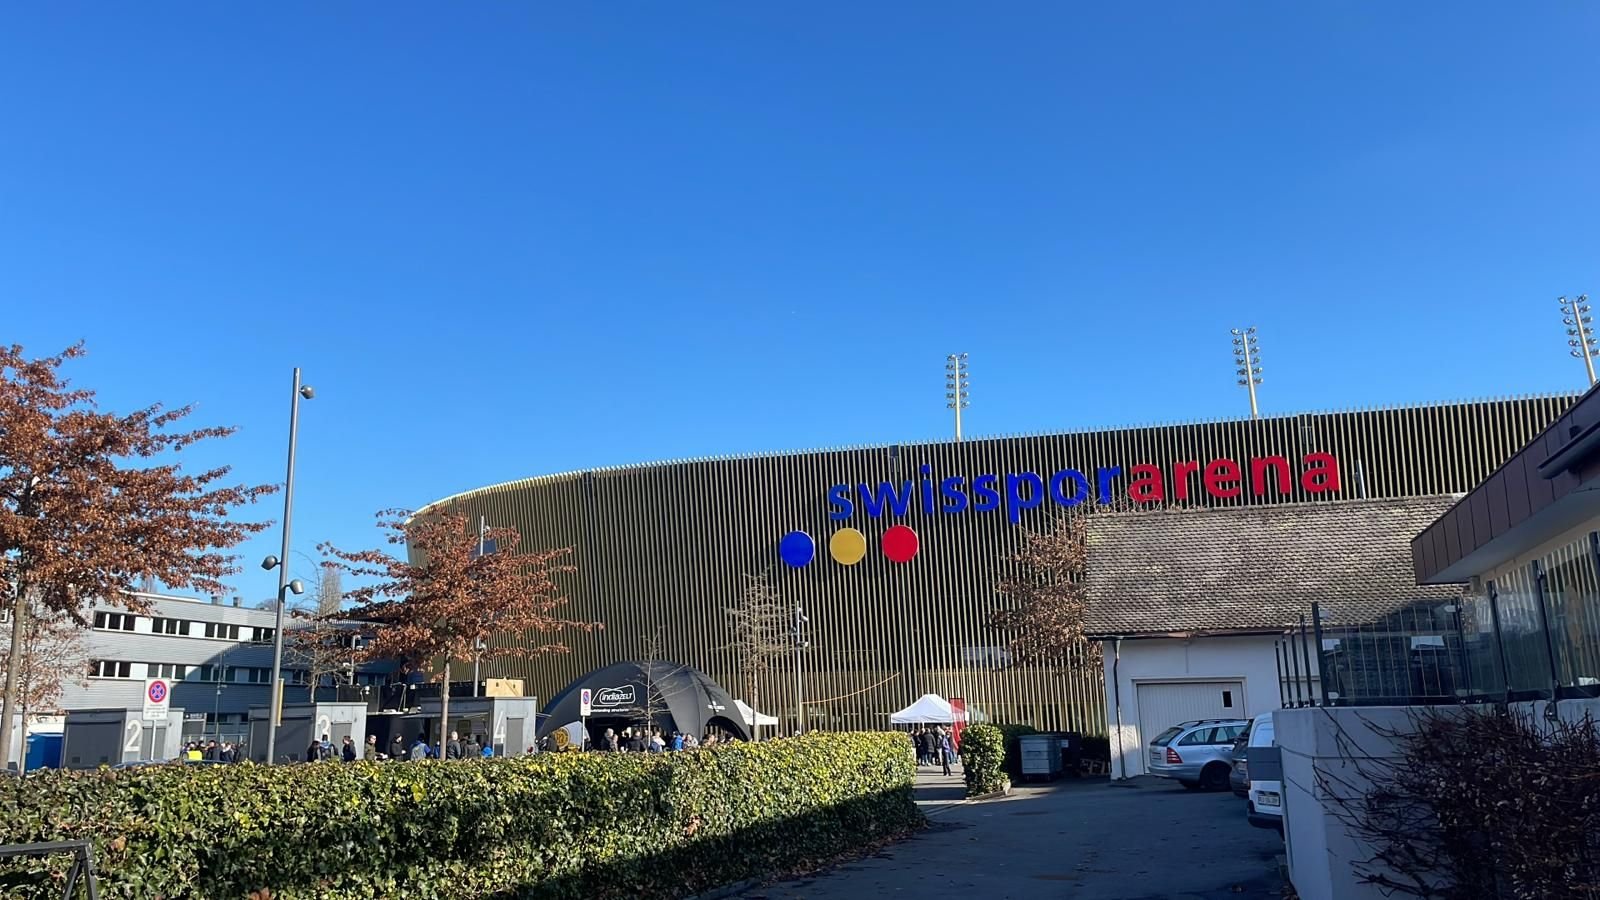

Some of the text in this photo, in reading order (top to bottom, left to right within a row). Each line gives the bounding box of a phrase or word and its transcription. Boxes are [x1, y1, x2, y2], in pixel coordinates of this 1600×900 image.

[828, 451, 1341, 525] swissporarena
[124, 719, 142, 752] 2
[494, 710, 506, 744] 4
